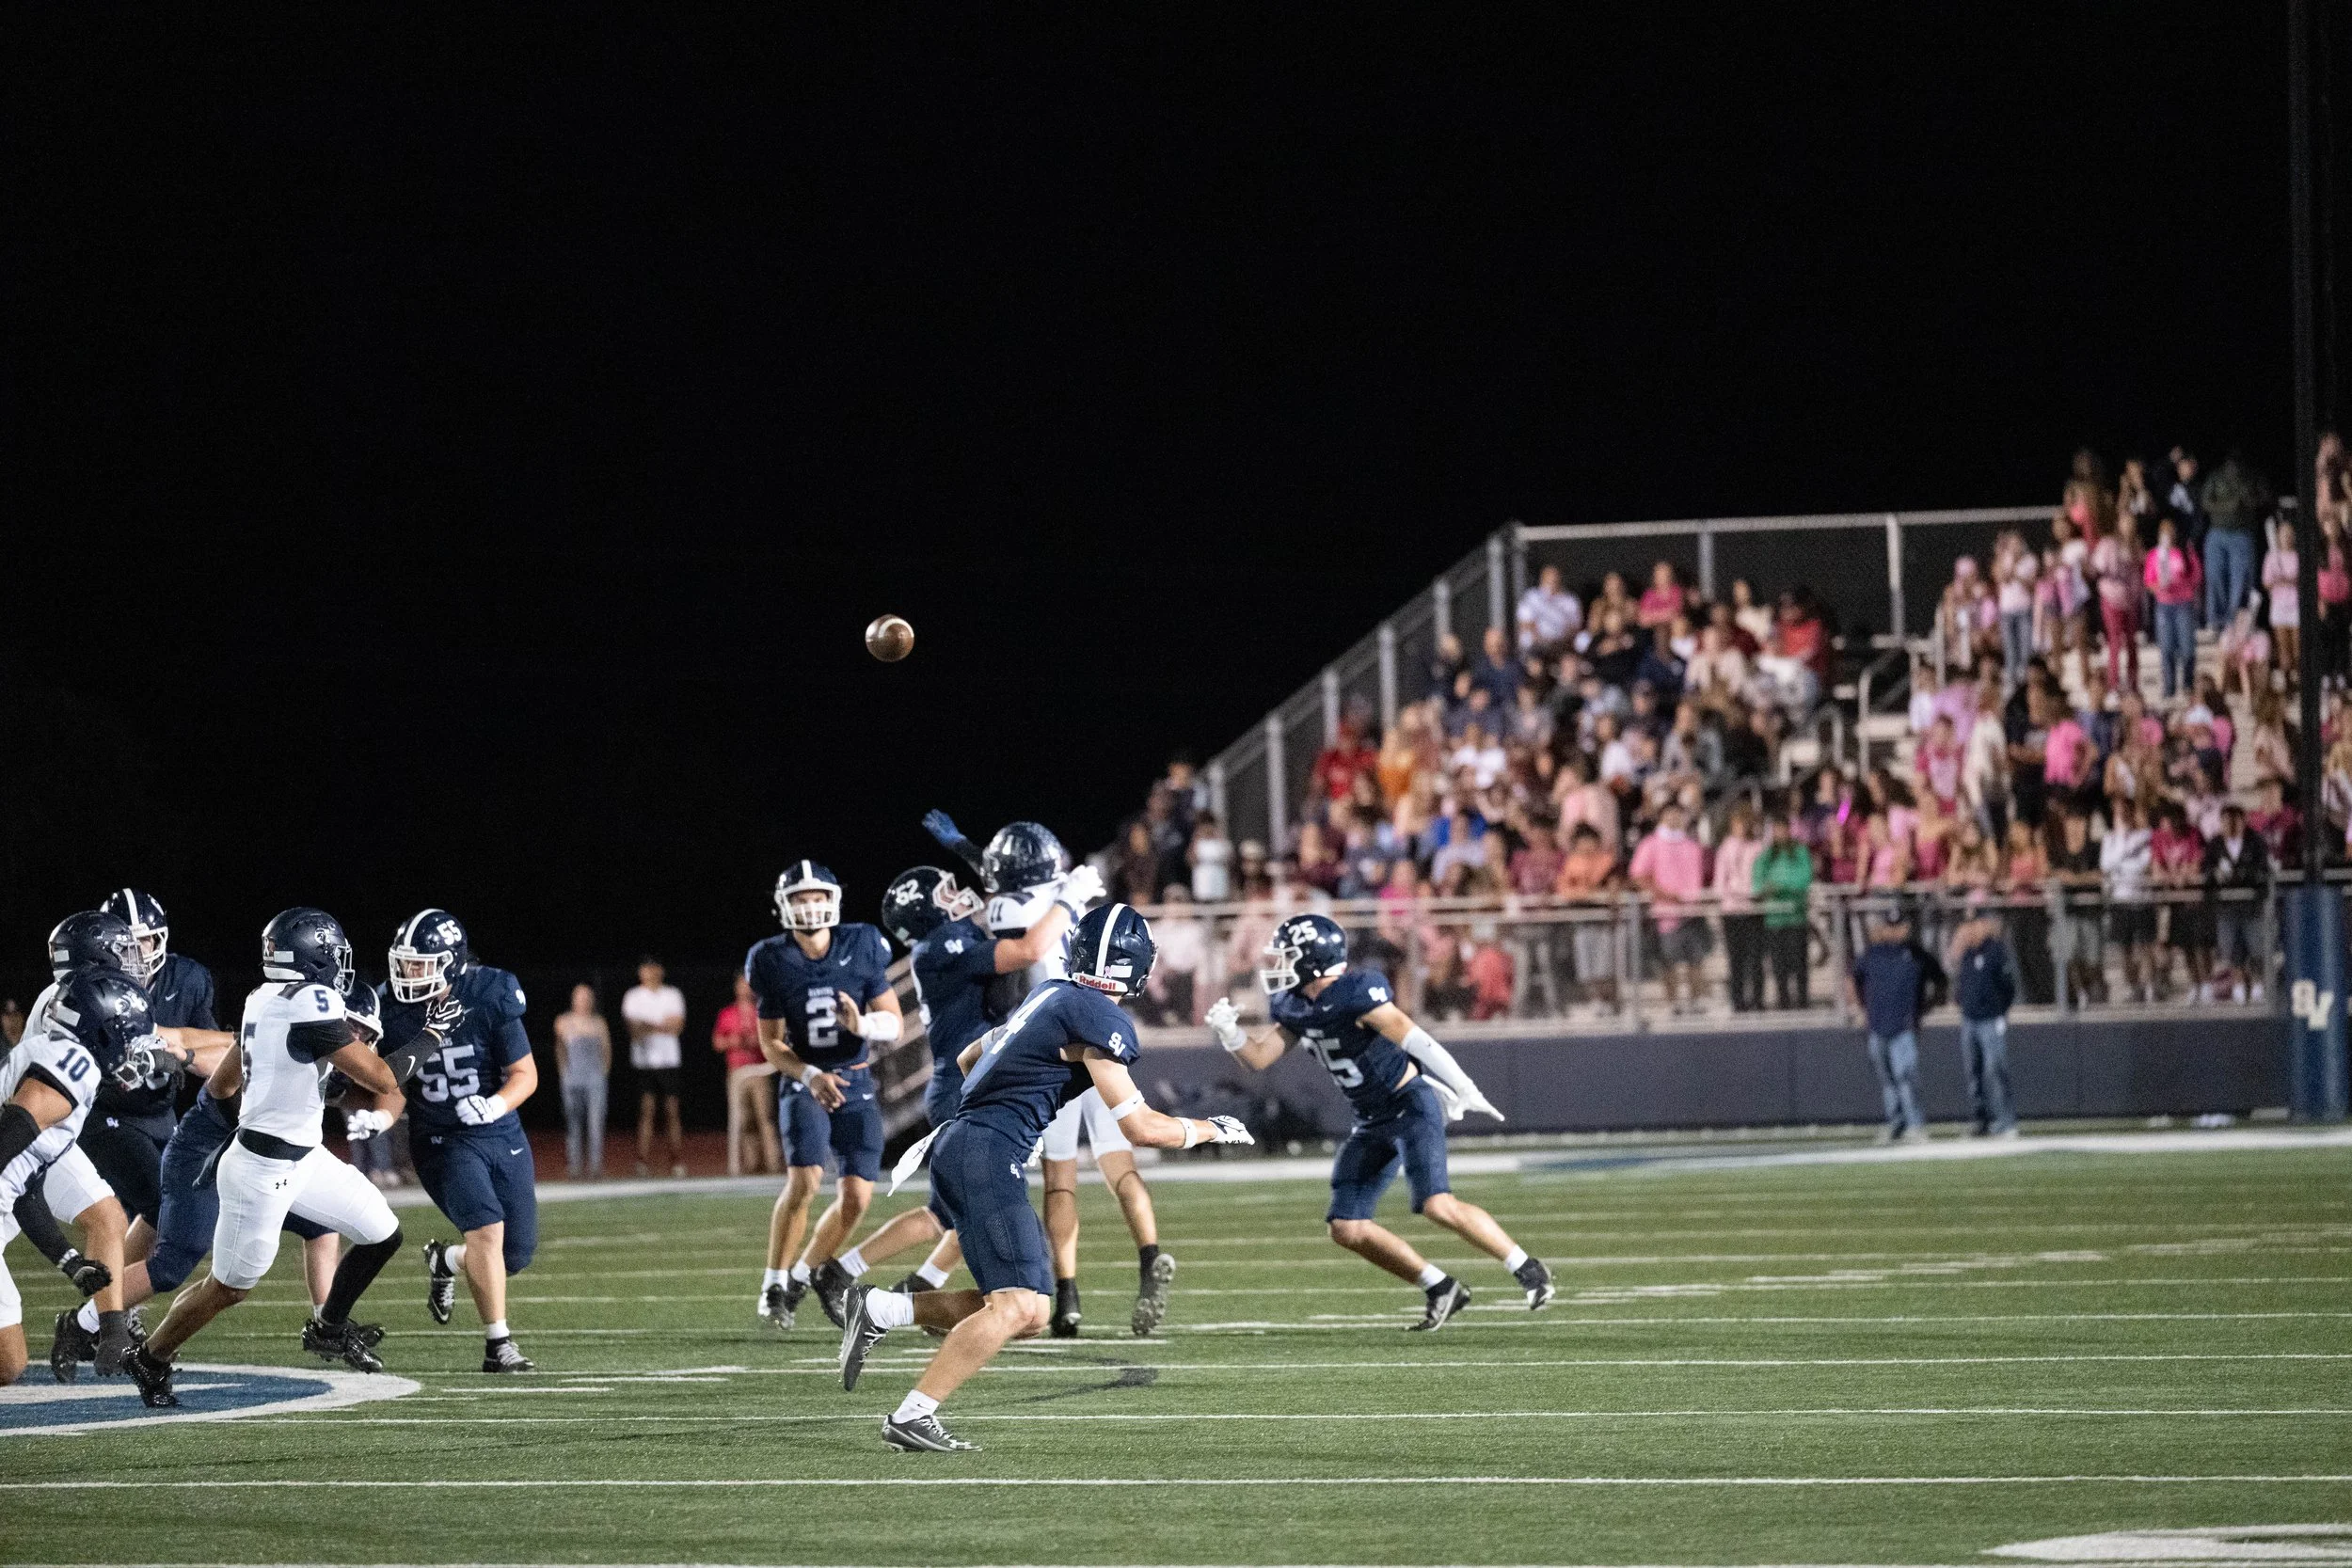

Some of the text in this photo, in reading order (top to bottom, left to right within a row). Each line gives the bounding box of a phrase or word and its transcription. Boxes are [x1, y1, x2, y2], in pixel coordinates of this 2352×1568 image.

[895, 879, 924, 906] 52
[990, 901, 1005, 922] 11
[436, 919, 463, 945] 55
[1287, 920, 1318, 946] 25
[1079, 974, 1117, 990] Riddell
[313, 990, 329, 1013] 5
[805, 997, 839, 1048] 2
[1108, 1032, 1126, 1057] SV
[56, 1047, 90, 1083] 10
[416, 1044, 481, 1102] 55
